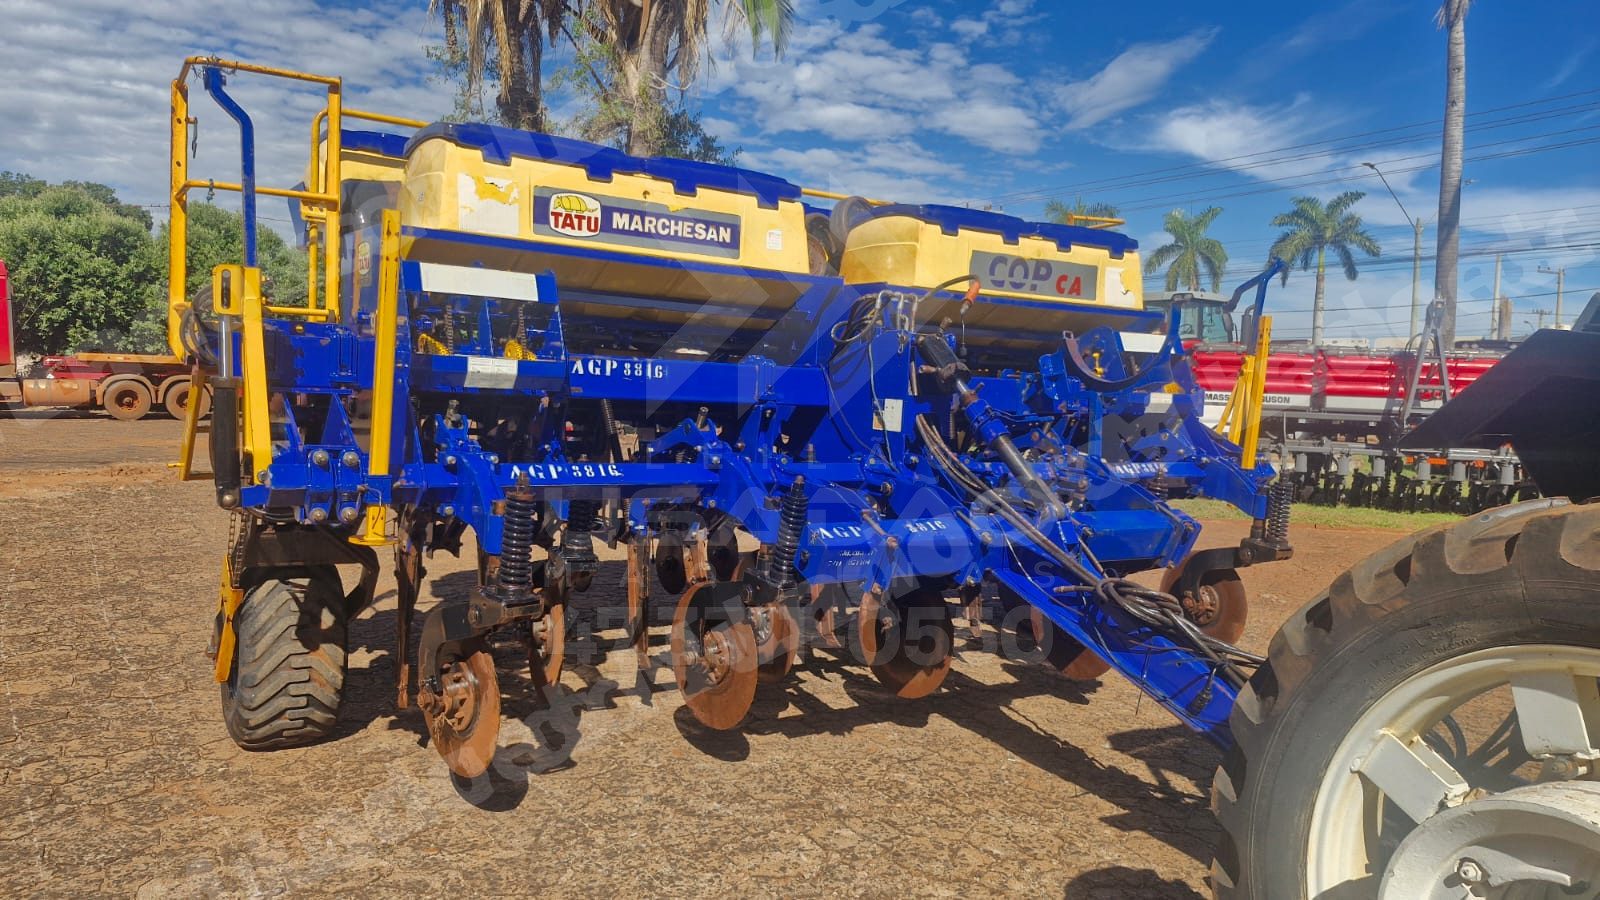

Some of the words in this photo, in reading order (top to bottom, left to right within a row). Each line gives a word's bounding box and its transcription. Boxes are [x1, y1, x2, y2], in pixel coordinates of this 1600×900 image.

[550, 211, 599, 233] TATU
[612, 211, 732, 243] MARCHESAN
[1055, 273, 1082, 296] CA
[571, 358, 618, 377] AGP
[1205, 392, 1230, 401] MASS
[510, 463, 562, 480] AGP
[818, 525, 862, 540] AGP
